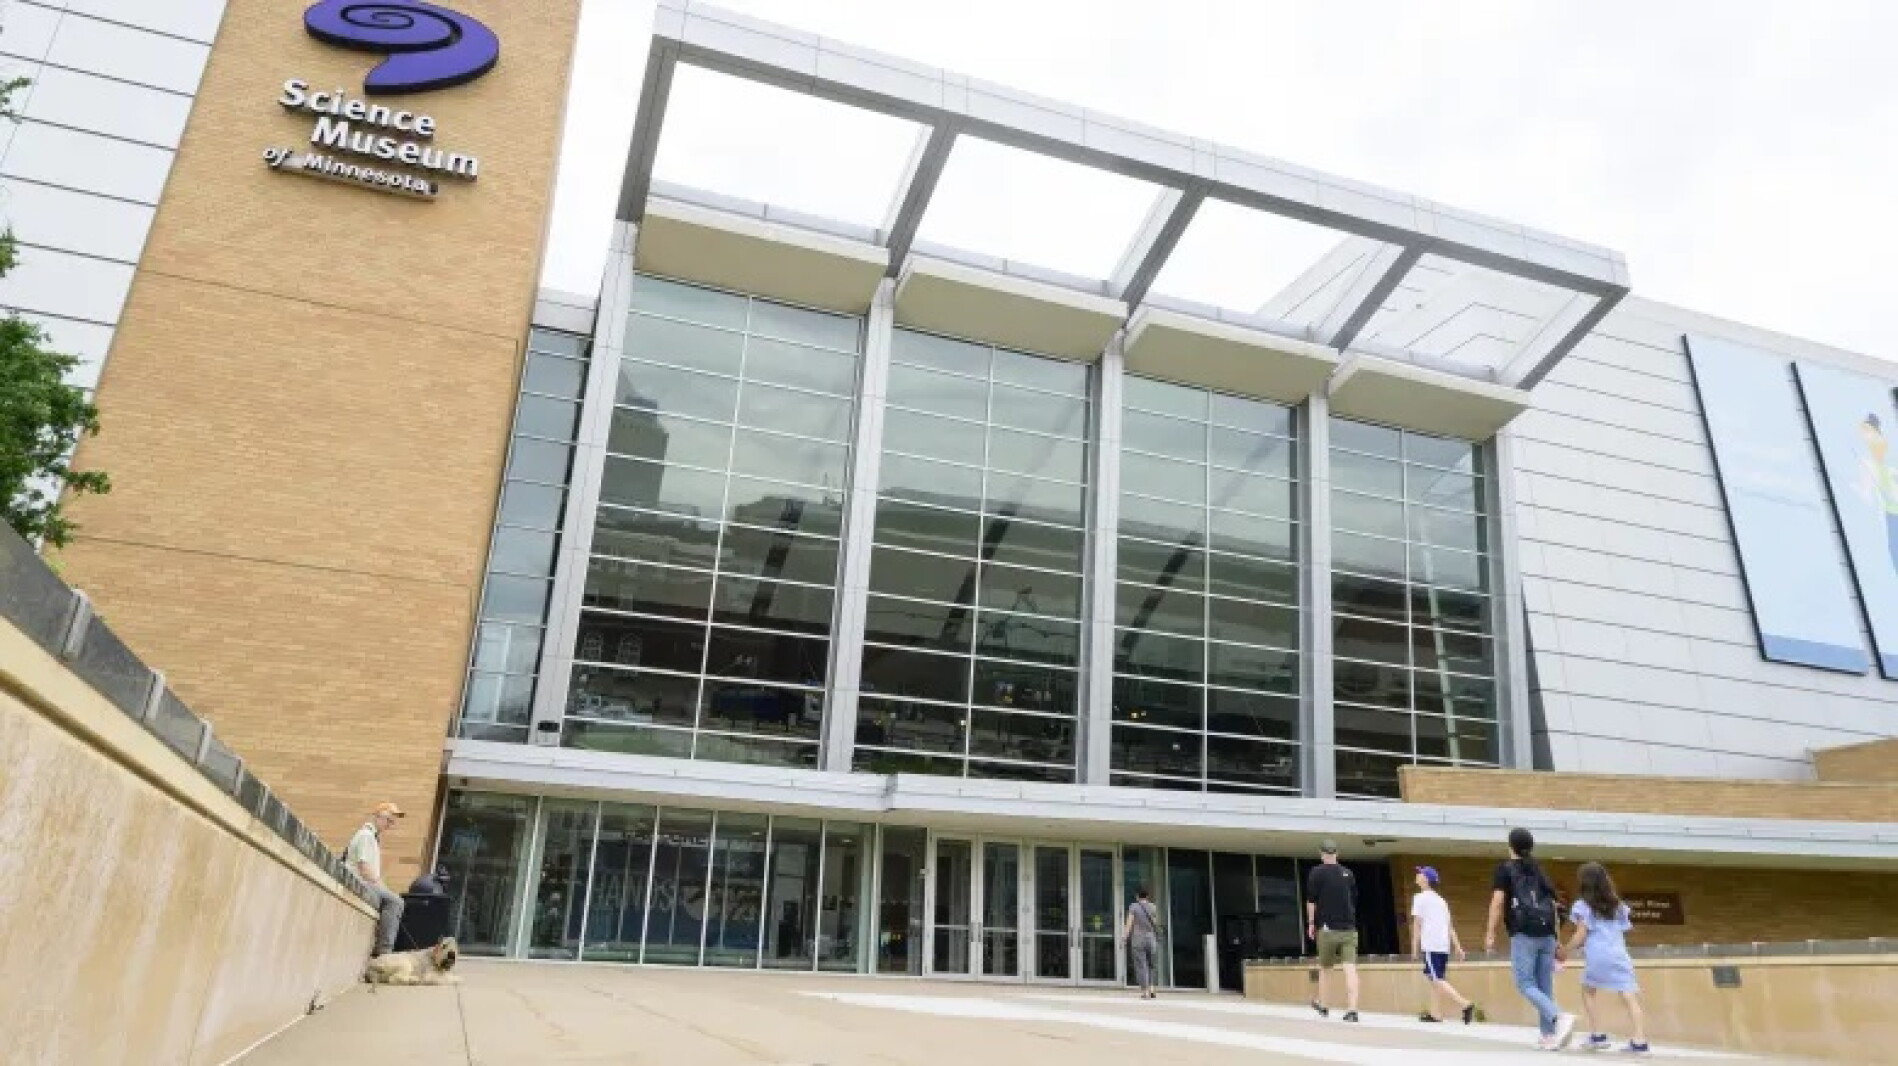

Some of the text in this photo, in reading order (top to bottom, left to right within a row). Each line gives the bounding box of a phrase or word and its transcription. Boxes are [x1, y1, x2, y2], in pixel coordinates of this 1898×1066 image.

[280, 79, 436, 136] Science
[263, 147, 427, 195] of Minnesota
[310, 116, 478, 178] Museum
